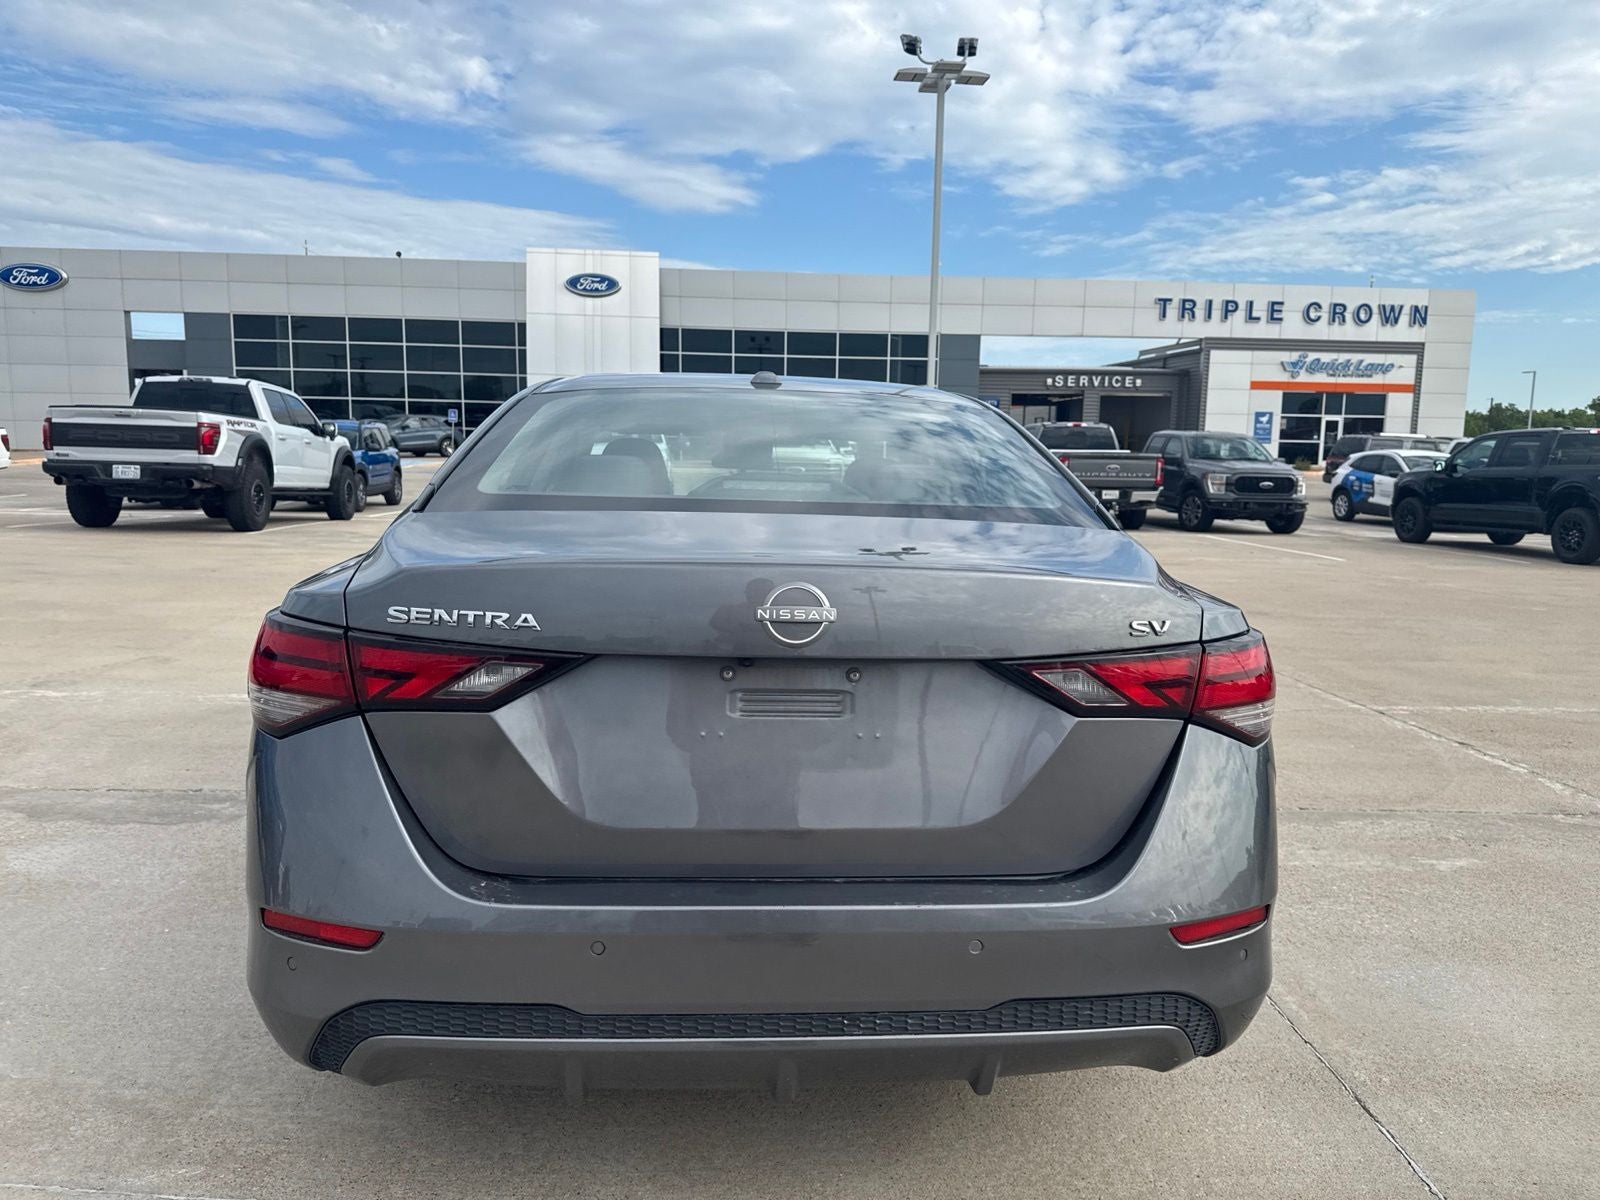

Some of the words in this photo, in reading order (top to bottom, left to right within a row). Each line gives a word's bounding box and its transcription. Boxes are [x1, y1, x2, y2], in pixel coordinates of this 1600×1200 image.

[9, 267, 49, 285] Ford
[577, 276, 609, 291] Ford
[1154, 297, 1285, 323] TRIPLE
[1302, 301, 1429, 328] CROWN
[1306, 357, 1354, 375] Quick
[1353, 359, 1396, 375] Lane
[1054, 375, 1135, 388] SERVICE
[226, 418, 258, 430] RAPTOR
[386, 605, 542, 631] SENTRA
[757, 608, 836, 621] NISSAN
[1129, 619, 1171, 637] SV
